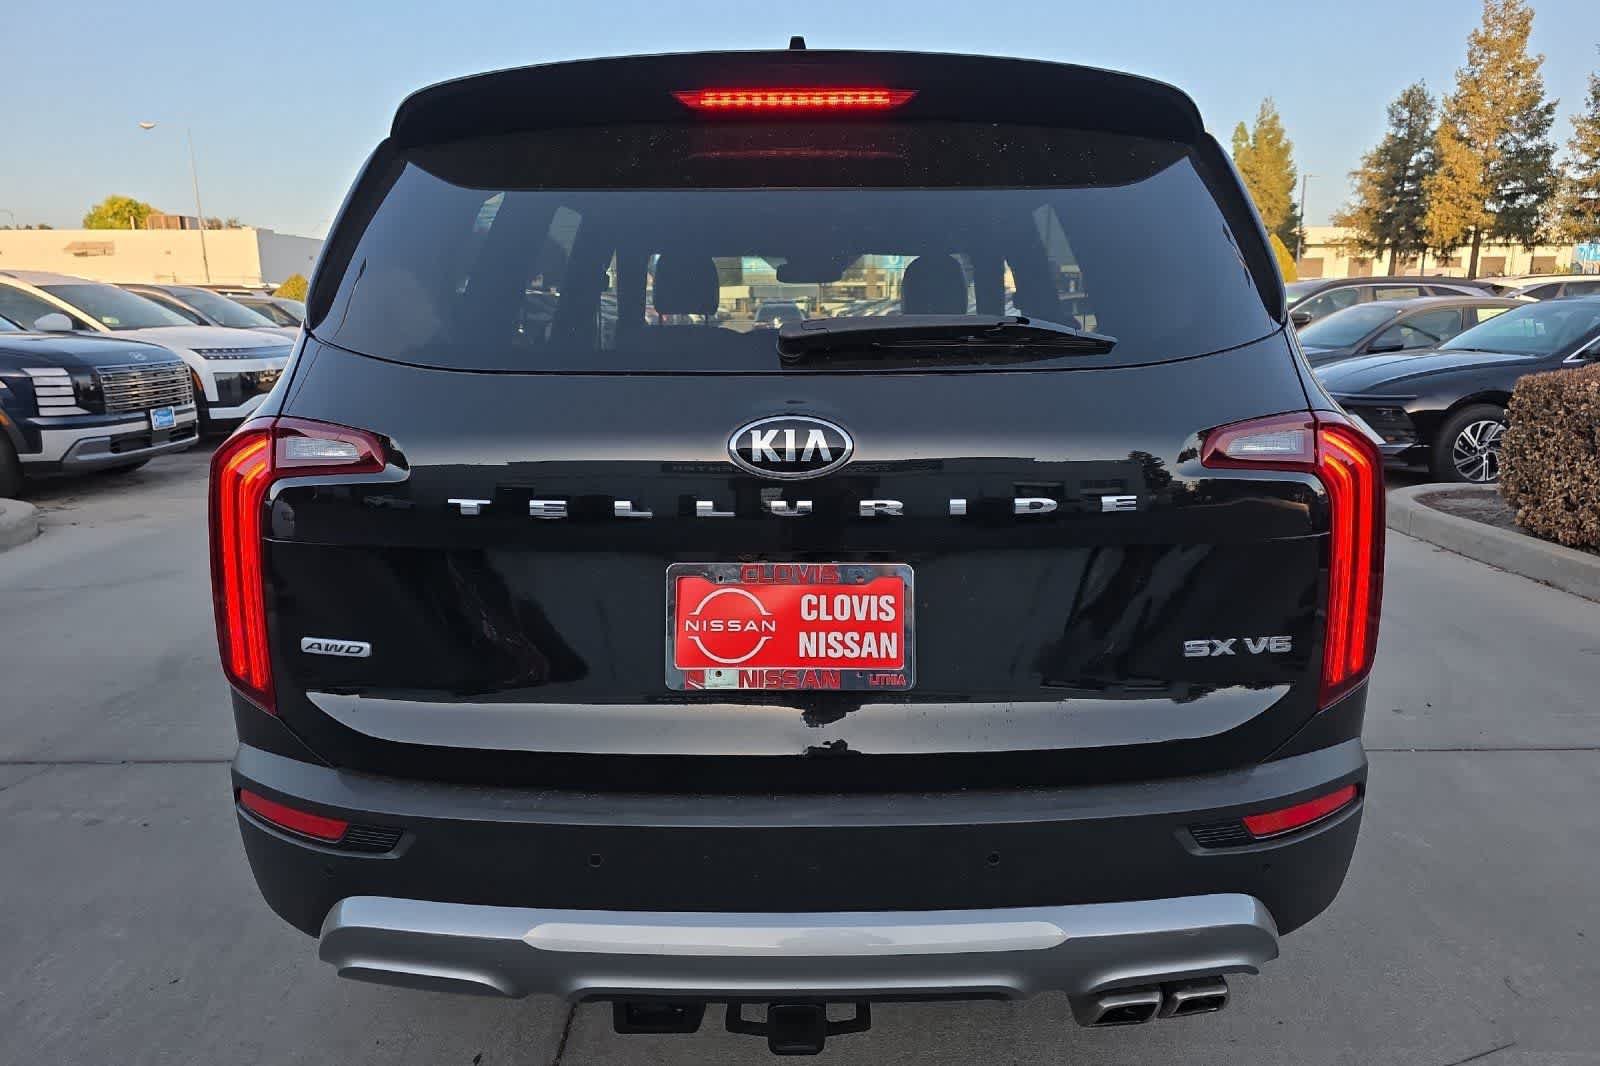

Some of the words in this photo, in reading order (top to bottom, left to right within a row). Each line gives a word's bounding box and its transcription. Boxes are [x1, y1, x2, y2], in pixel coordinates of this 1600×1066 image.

[750, 429, 833, 462] KIA
[447, 495, 1137, 519] TELLURIDE
[740, 564, 839, 584] CLOVIS
[800, 594, 895, 622] CLOVIS
[685, 619, 776, 633] NISSAN
[305, 642, 364, 654] AWD
[799, 632, 897, 659] NISSAN
[1184, 638, 1237, 657] SX
[1244, 636, 1292, 654] V6
[738, 669, 841, 688] NISSAN
